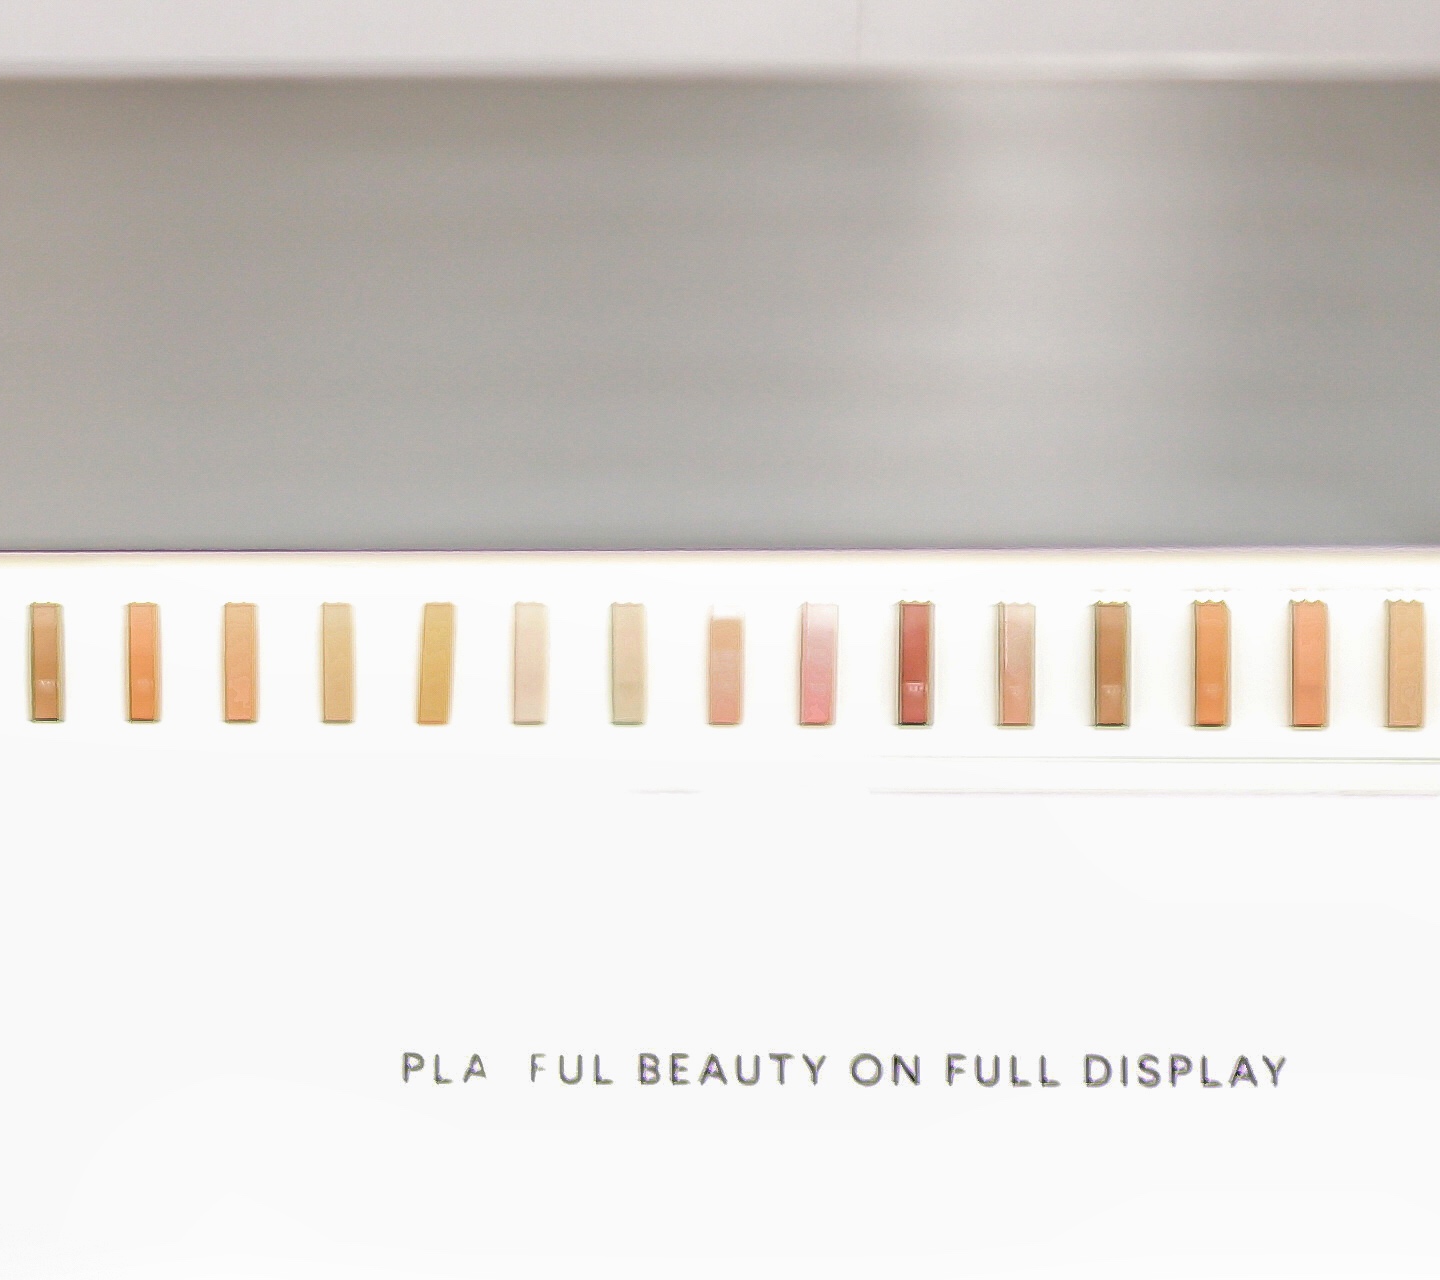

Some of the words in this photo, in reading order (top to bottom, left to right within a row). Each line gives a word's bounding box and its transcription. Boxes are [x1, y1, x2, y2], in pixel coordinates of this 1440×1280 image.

[401, 1050, 614, 1087] PLAFUL
[637, 1050, 828, 1087] BEAUTY
[848, 1050, 922, 1088] ON
[944, 1050, 1061, 1089] FULL
[1082, 1050, 1287, 1089] DISPLAY
